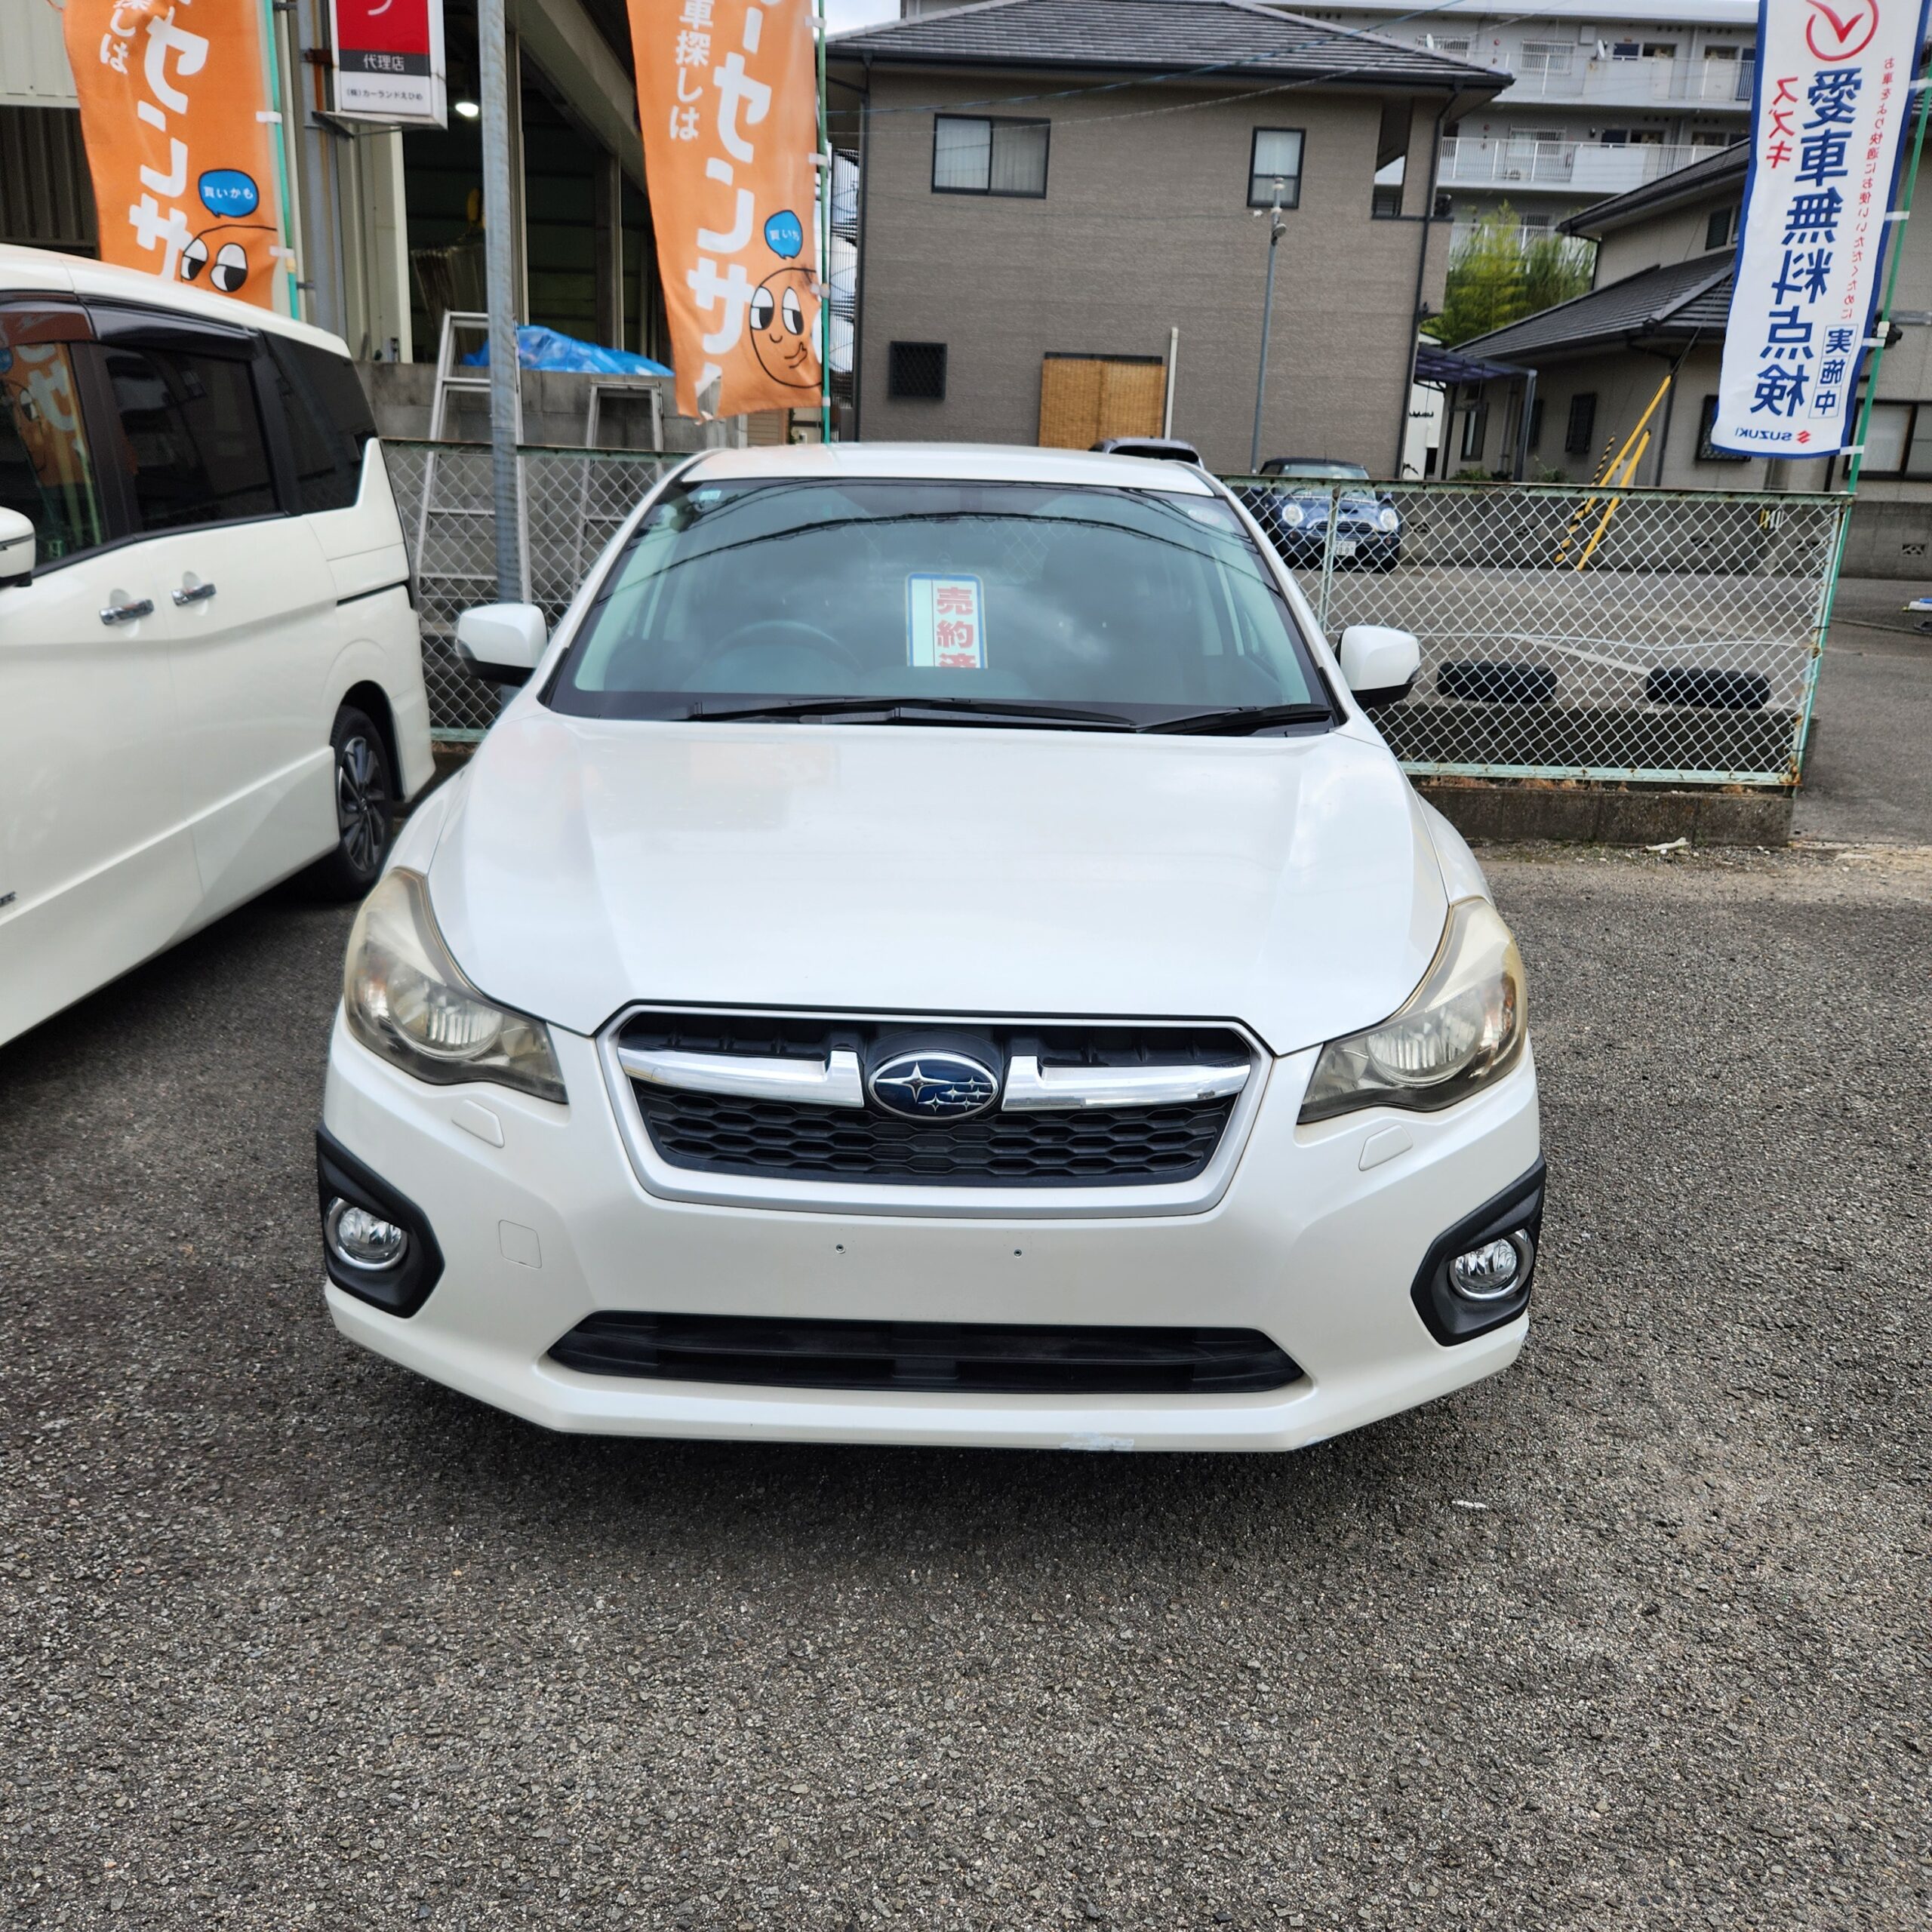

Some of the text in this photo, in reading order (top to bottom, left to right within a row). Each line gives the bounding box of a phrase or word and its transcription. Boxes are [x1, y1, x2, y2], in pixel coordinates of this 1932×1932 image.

[363, 54, 405, 72] 代理店
[129, 0, 208, 279] センサ
[202, 185, 254, 200] 買いかも
